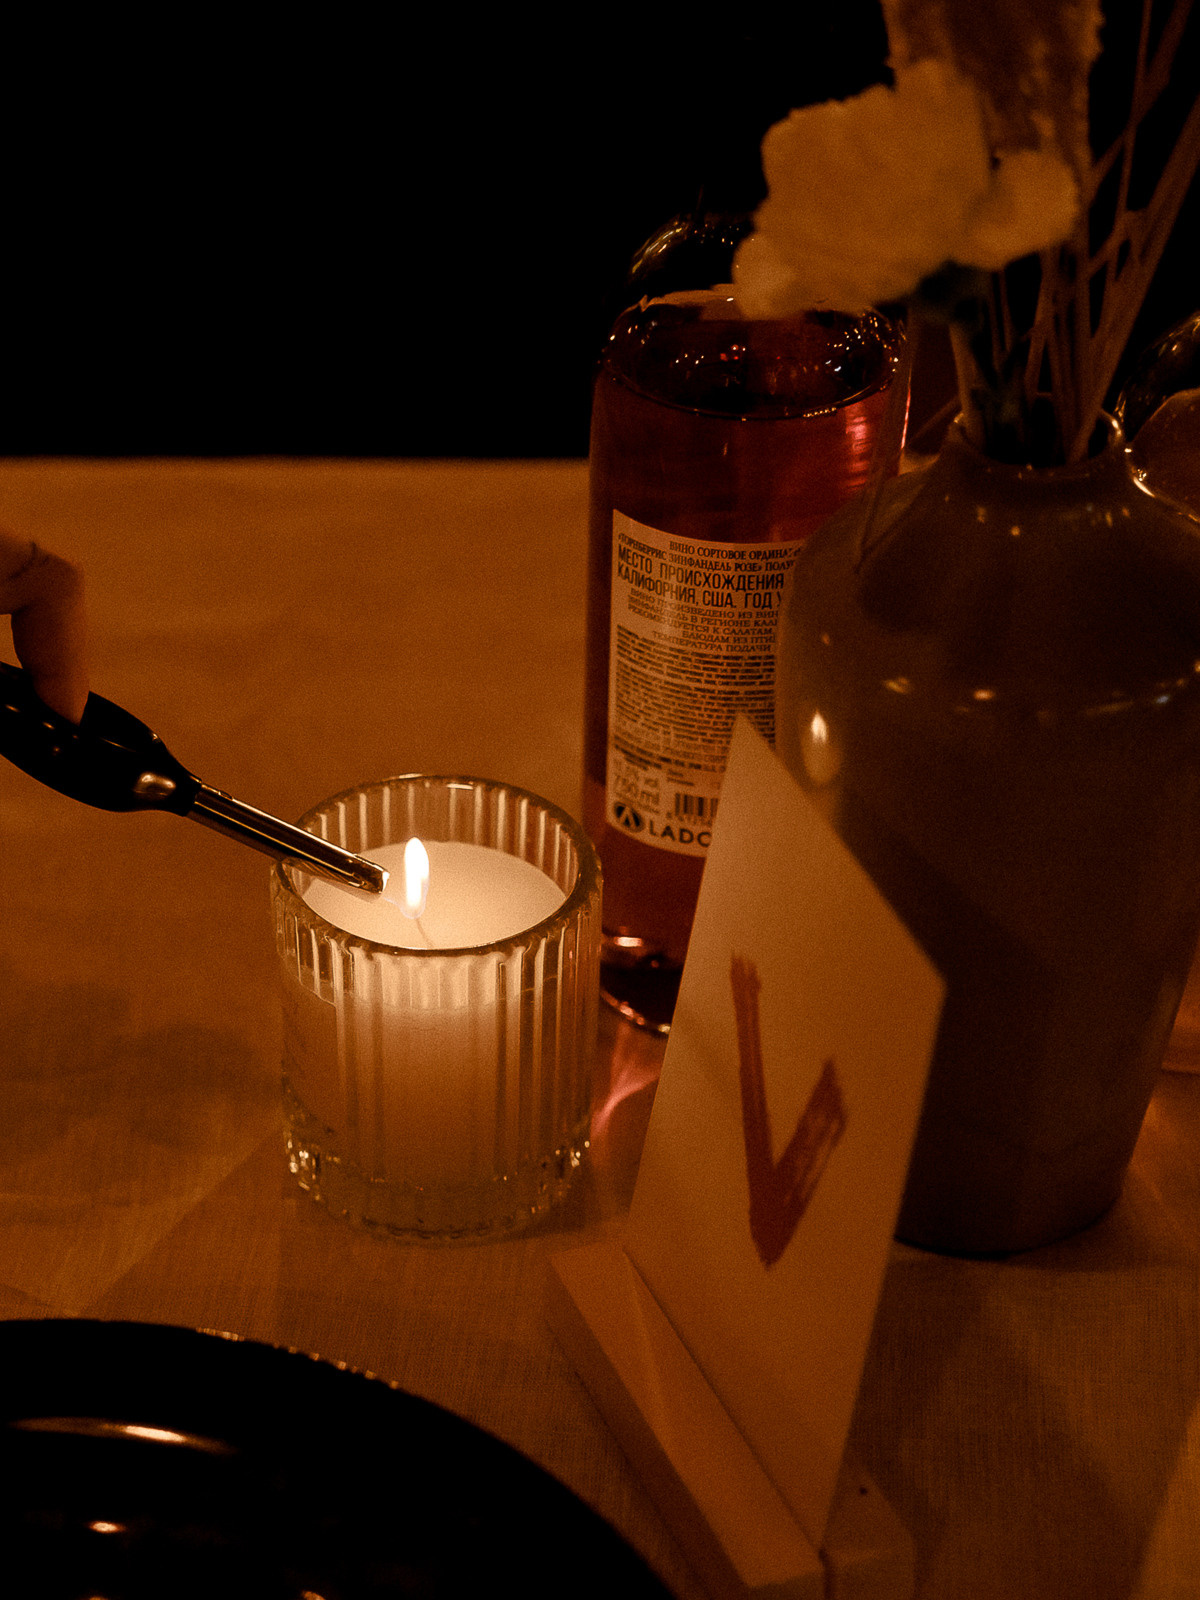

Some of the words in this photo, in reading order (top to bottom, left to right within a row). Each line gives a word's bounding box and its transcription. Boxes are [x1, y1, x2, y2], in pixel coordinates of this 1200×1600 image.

[669, 541, 695, 555] ВИНО
[697, 546, 746, 560] СОРТОВОЕ
[618, 543, 652, 574] МЕСТО
[659, 562, 784, 592] ПРОИСХОЖДЕНИЯ
[668, 552, 732, 571] ЗИНФАНДЕЛЬ
[617, 561, 699, 606] КАЛИФОРНИЯ,
[744, 592, 772, 609] ГОД
[701, 617, 750, 627] РЕГИОНЕ
